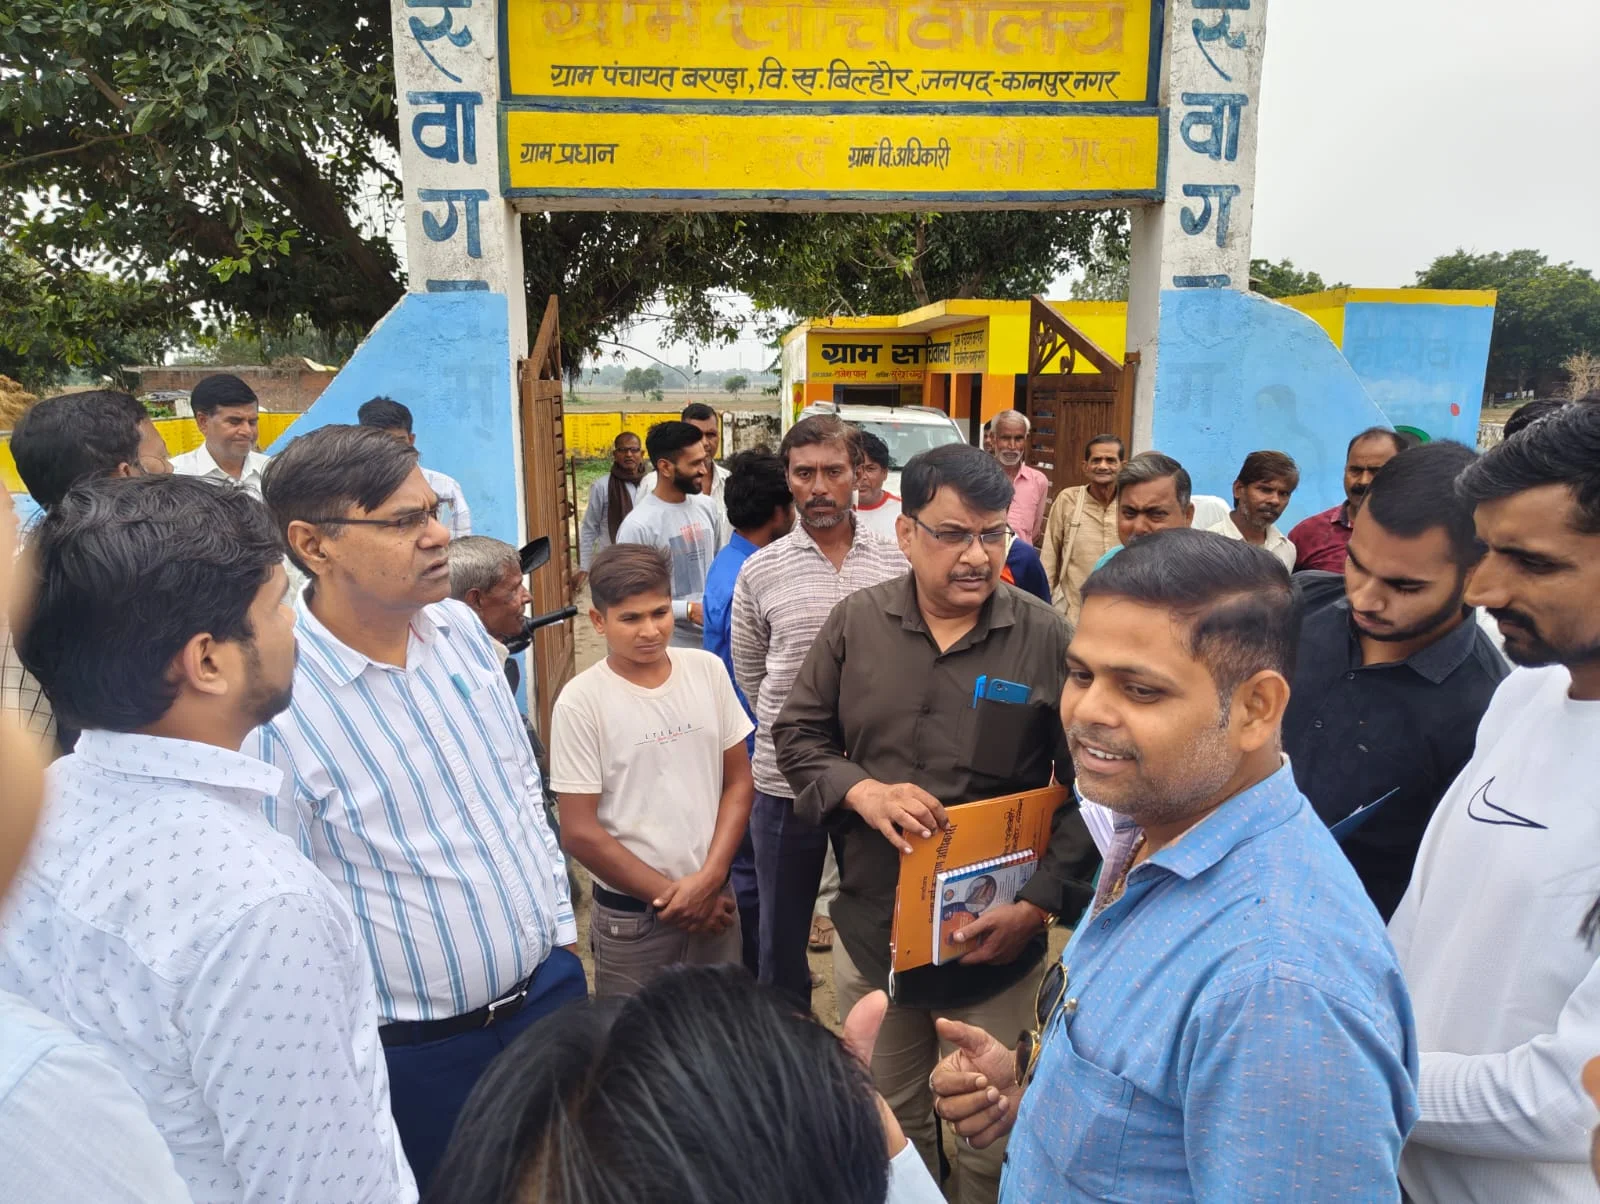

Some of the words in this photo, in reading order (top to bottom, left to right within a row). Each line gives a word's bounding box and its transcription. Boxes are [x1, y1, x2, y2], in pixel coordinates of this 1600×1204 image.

[550, 64, 599, 87] ग्राम
[601, 60, 680, 92] पंचायत
[1073, 71, 1121, 99] नगर
[520, 143, 556, 164] ग्राम
[555, 143, 619, 164] प्रधान
[848, 146, 877, 168] ग्राम
[821, 343, 883, 365] ग्राम
